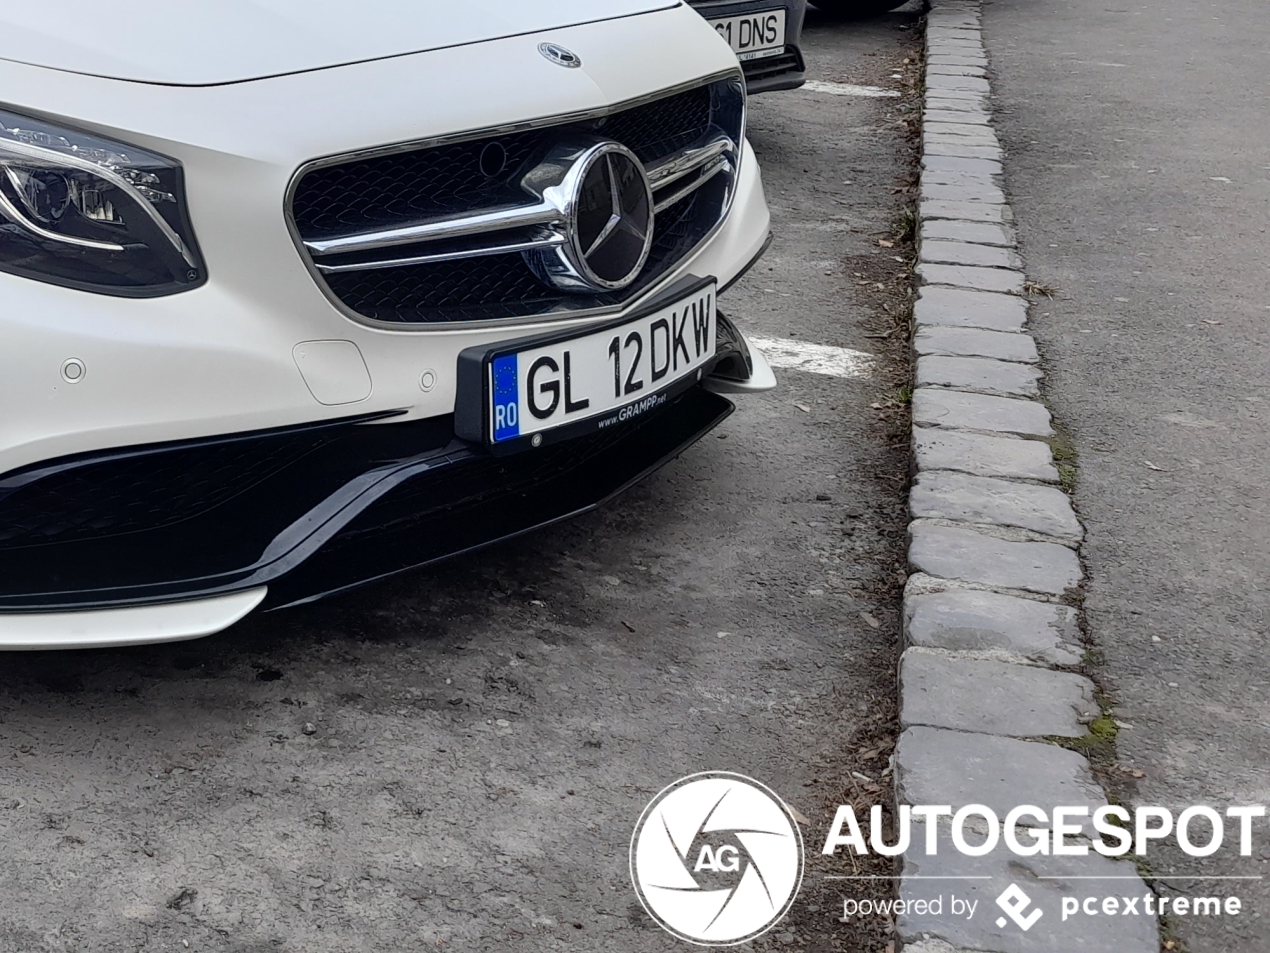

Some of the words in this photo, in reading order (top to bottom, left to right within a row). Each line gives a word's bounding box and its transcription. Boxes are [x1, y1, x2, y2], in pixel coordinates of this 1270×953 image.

[738, 14, 778, 49] DNS
[526, 350, 590, 420] GL
[495, 401, 517, 430] RO
